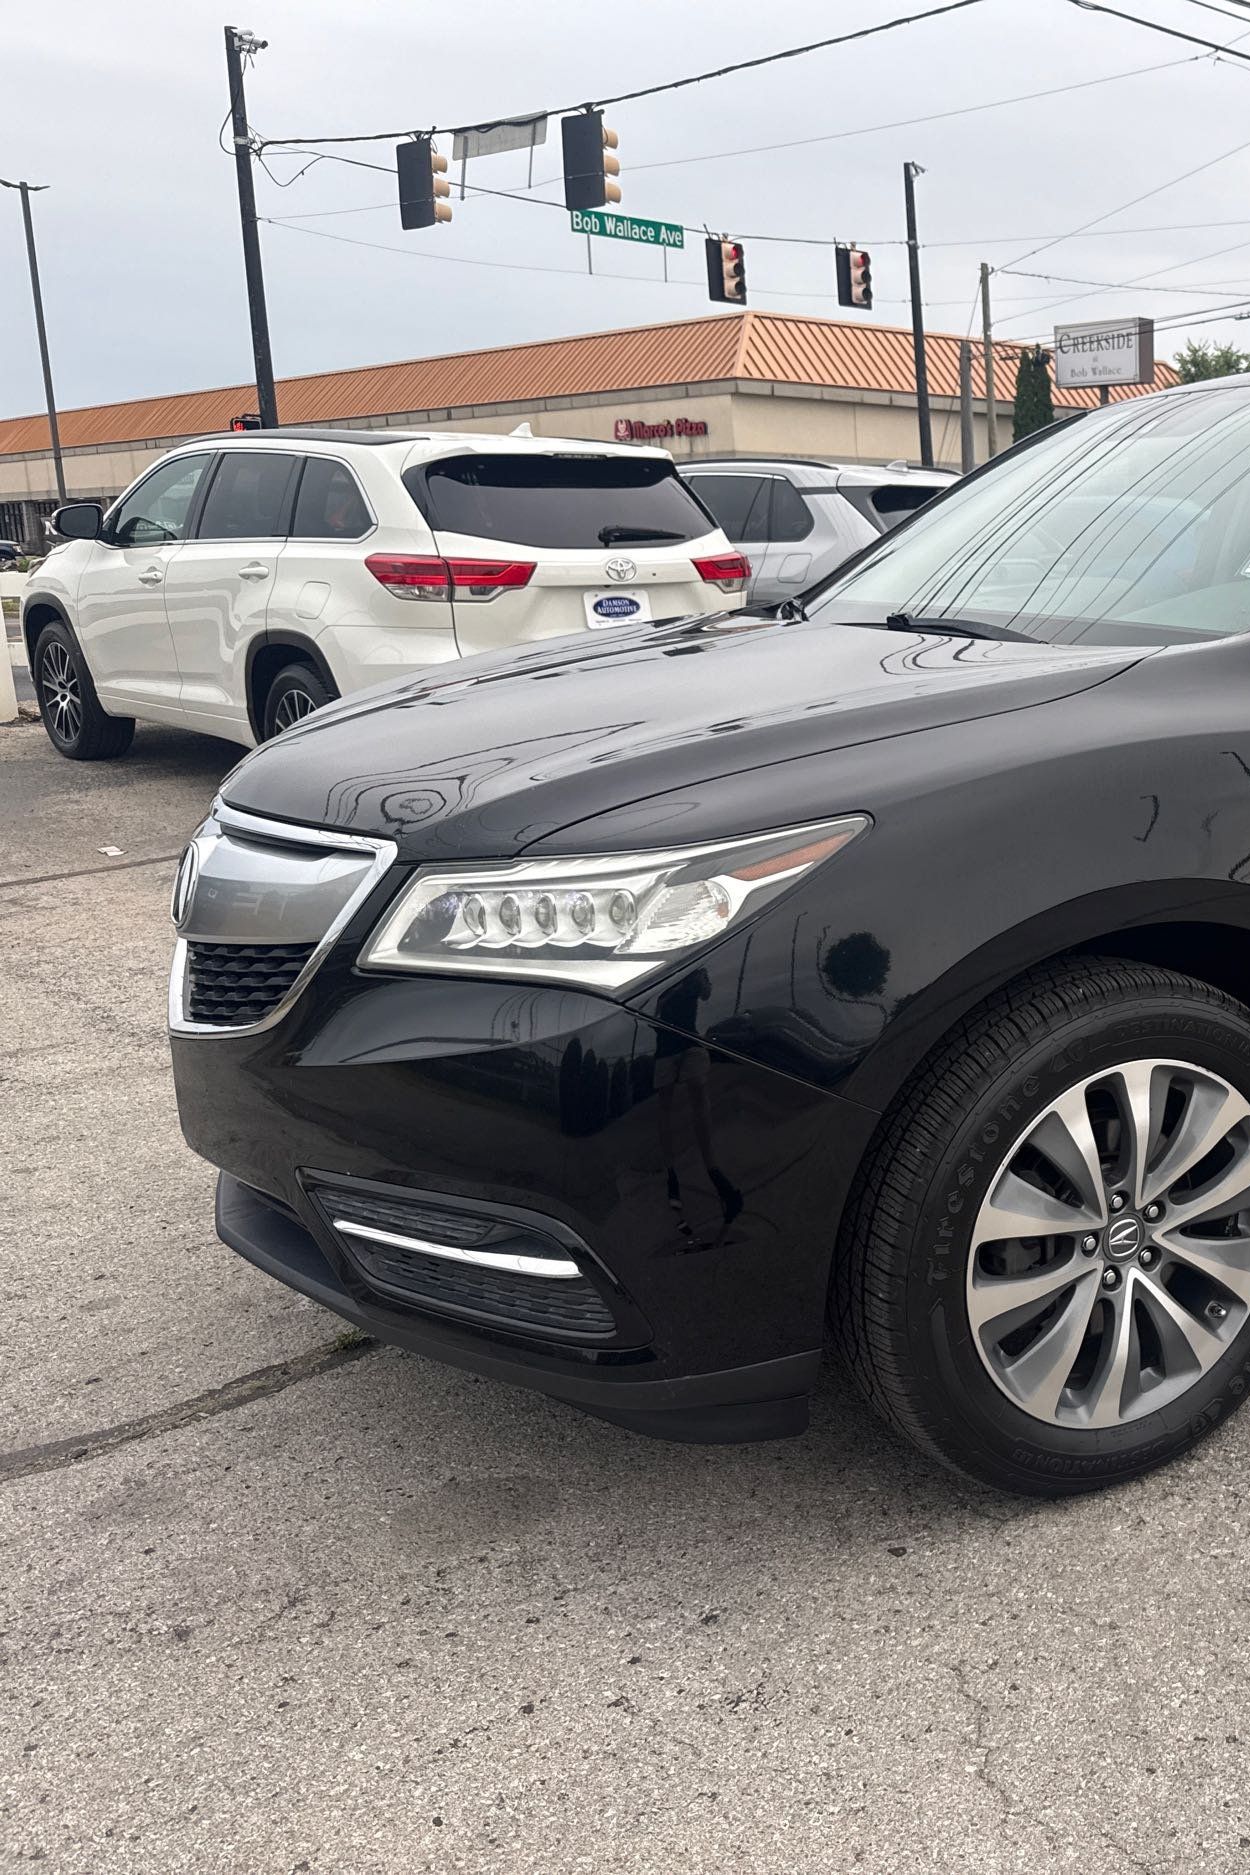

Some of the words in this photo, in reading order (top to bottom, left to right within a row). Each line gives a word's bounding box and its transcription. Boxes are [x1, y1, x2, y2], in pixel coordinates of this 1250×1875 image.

[572, 211, 600, 233] Bob
[604, 215, 655, 241] Wallace
[659, 225, 682, 246] Ave
[1060, 333, 1133, 354] CREEKSIDE
[1070, 368, 1088, 379] Bob
[1091, 364, 1122, 376] Wallace
[634, 421, 673, 439] Marco's
[675, 418, 705, 437] Pizza
[597, 605, 637, 614] AUTOMOTIVE
[602, 599, 630, 607] DAMSON
